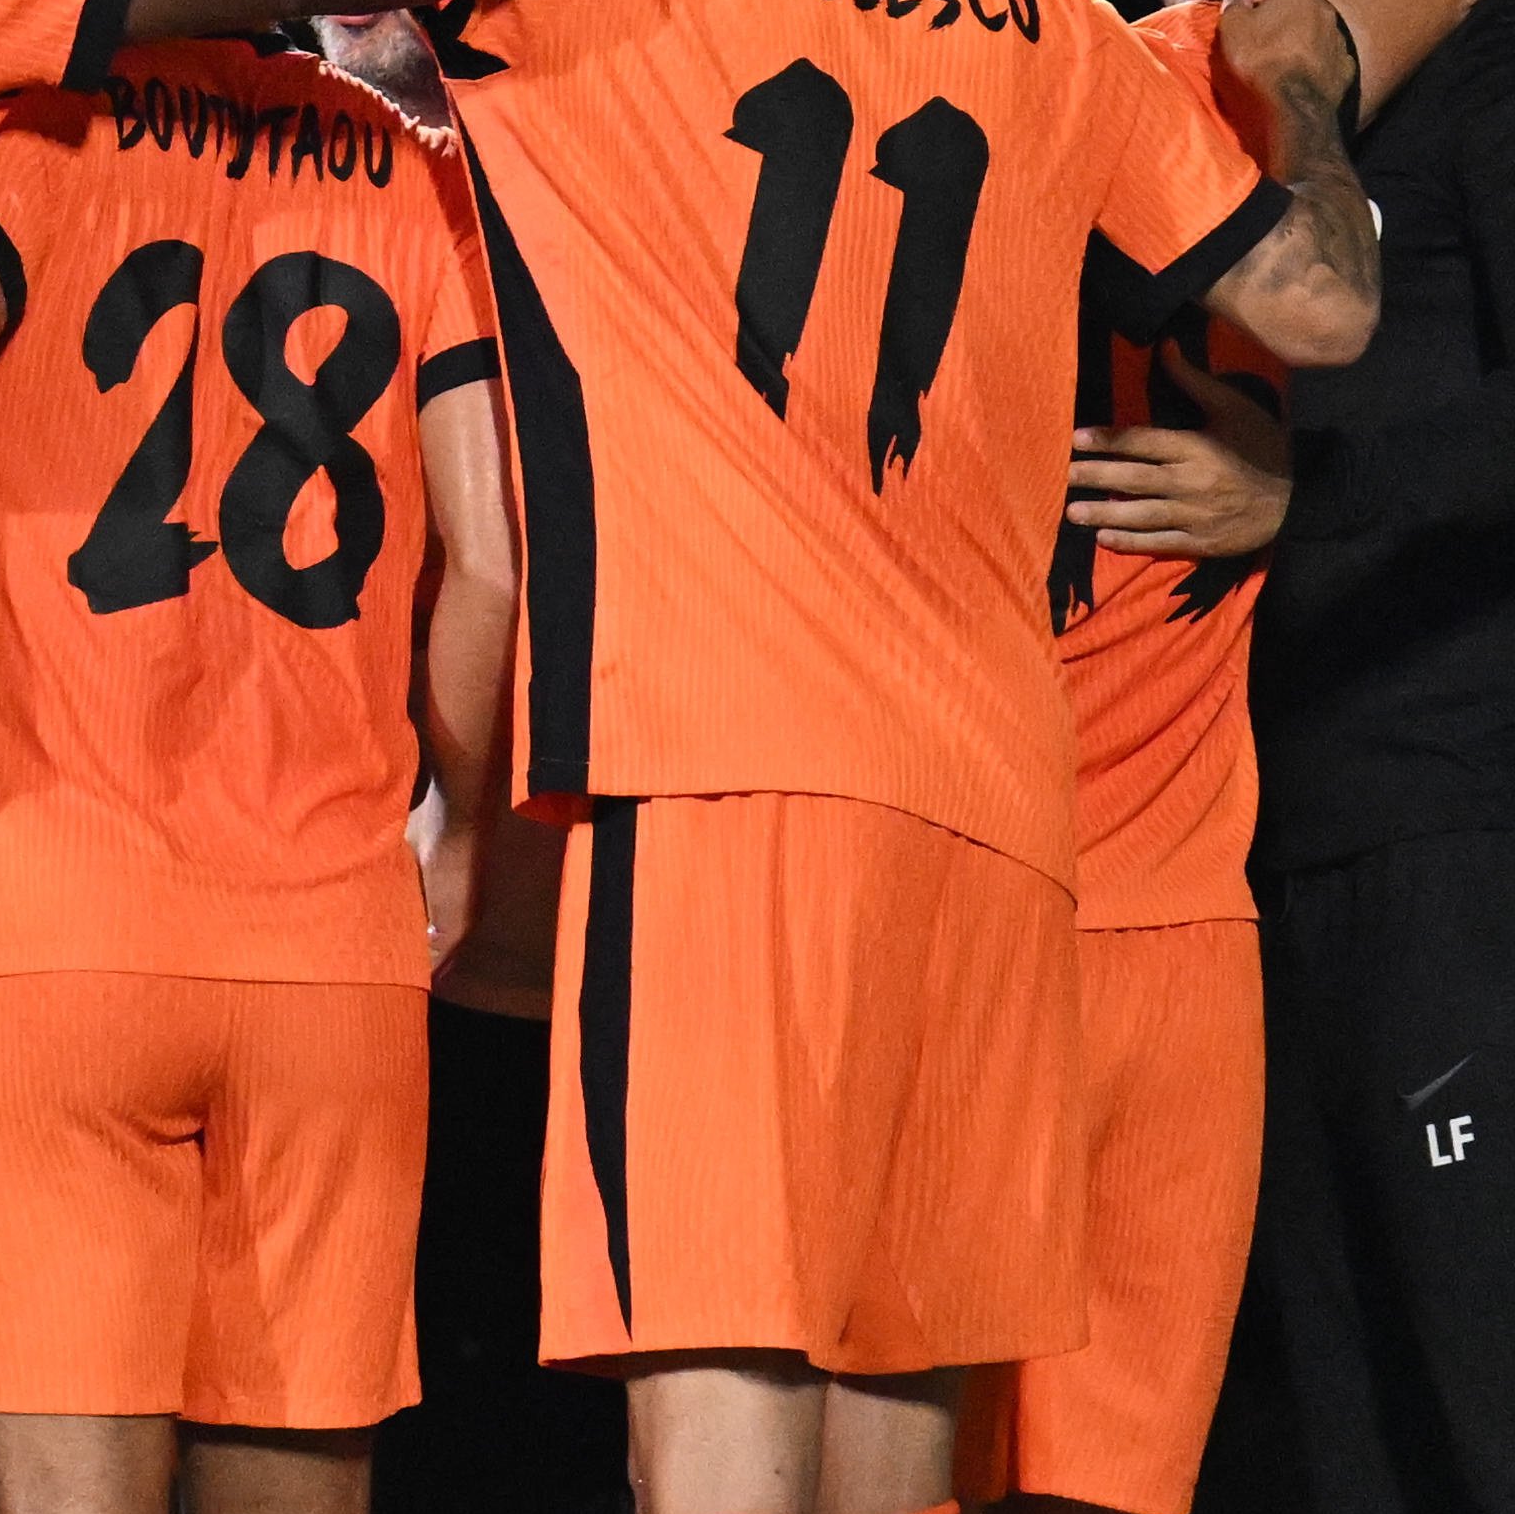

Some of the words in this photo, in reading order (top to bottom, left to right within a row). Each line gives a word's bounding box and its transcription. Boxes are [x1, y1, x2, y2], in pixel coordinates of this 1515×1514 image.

[68, 239, 401, 630] 28
[722, 57, 990, 498] 11
[1425, 1114, 1476, 1168] LF
